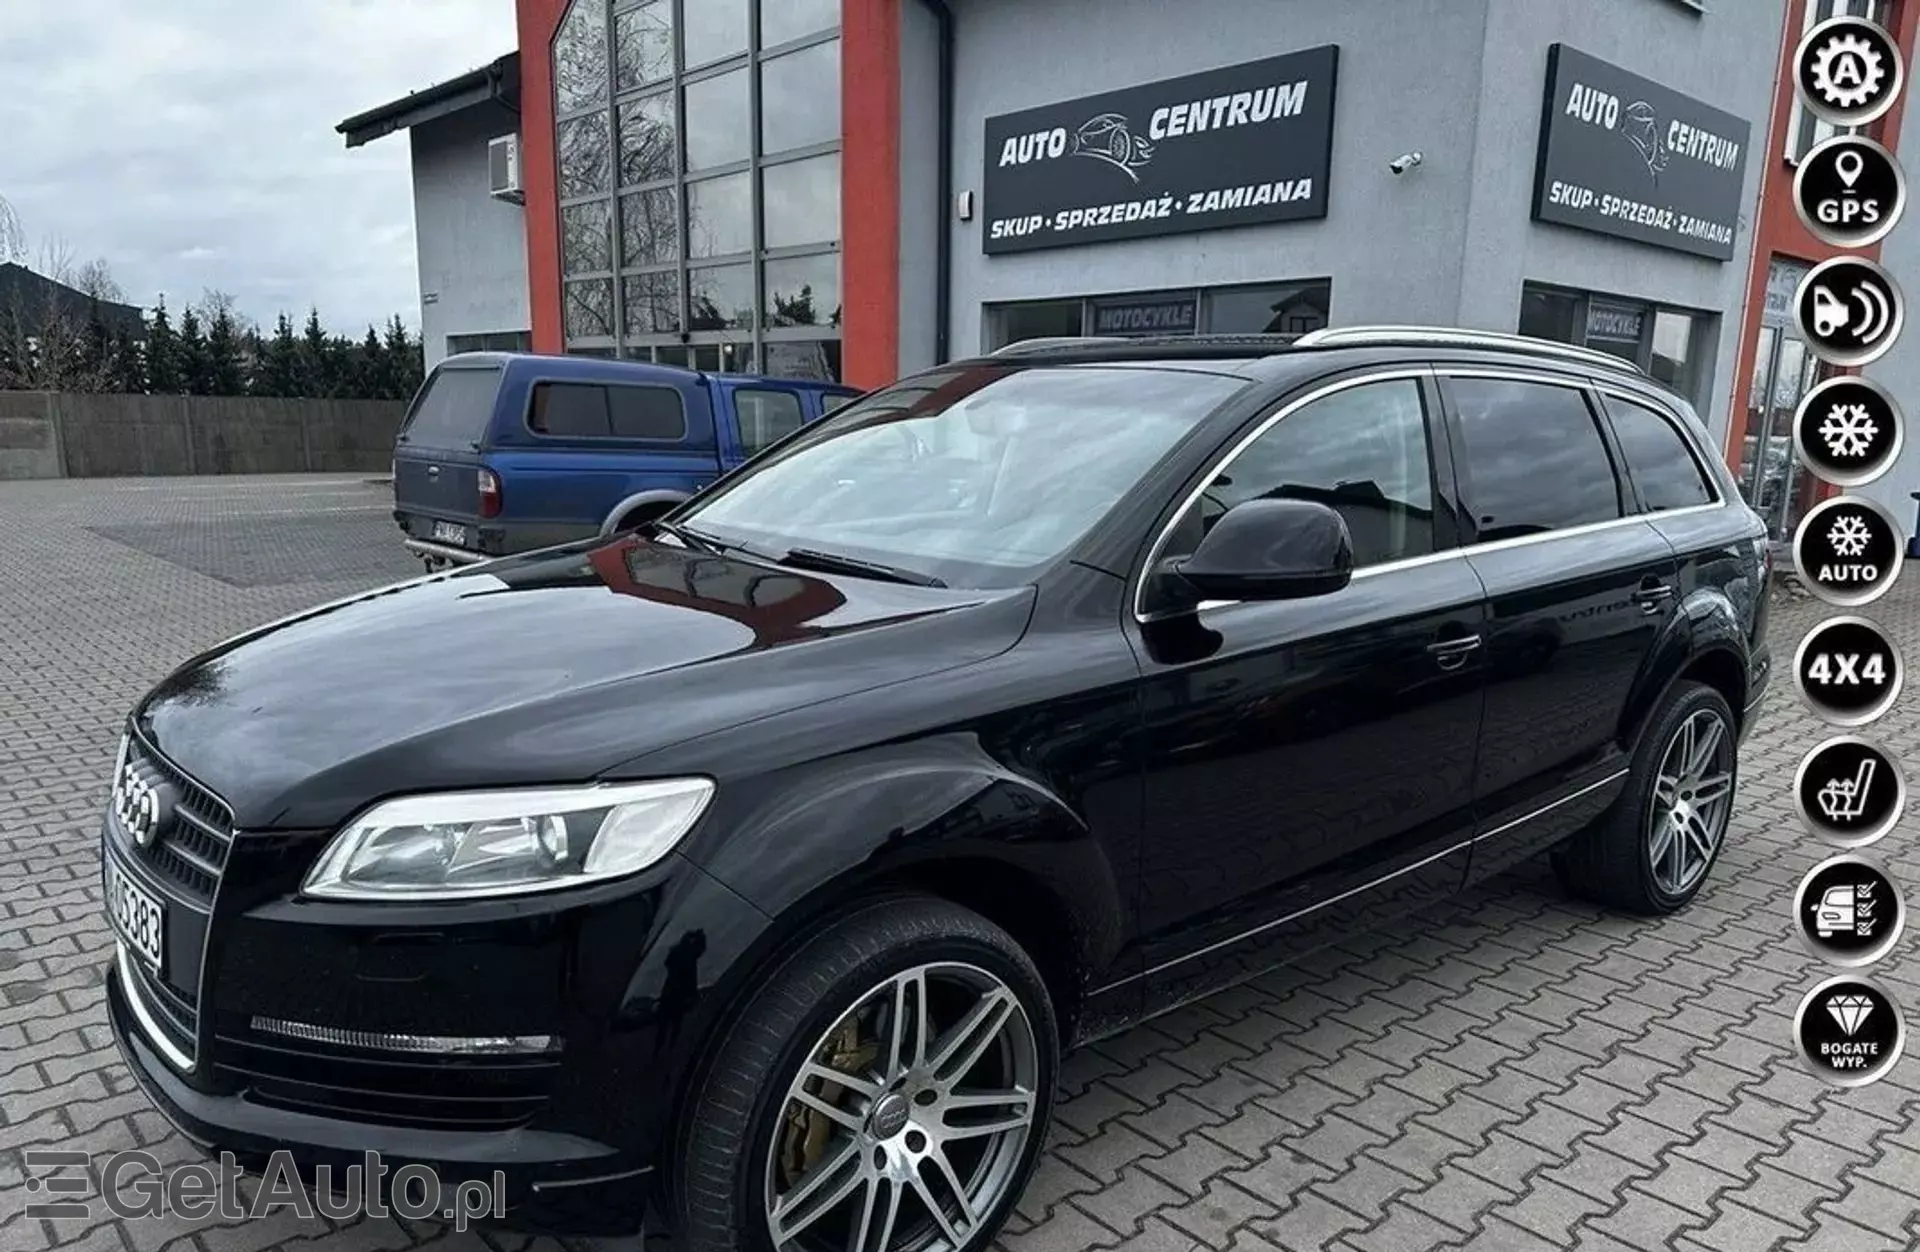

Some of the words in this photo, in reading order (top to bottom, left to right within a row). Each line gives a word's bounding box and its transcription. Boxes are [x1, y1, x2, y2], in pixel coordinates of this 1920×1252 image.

[999, 127, 1066, 167] AUTO
[1149, 81, 1308, 140] CENTRUM
[1565, 83, 1619, 130] AUTO
[1667, 119, 1740, 172] CENTRUM
[990, 215, 1043, 239] SKUP
[1054, 192, 1172, 231] SPRZEDAŻ
[1186, 178, 1312, 214] ZAMIANA
[1549, 180, 1593, 210] SKUP
[1600, 194, 1673, 231] SPRZEDAŻ
[1678, 214, 1733, 245] ZAMIANA
[1099, 303, 1194, 331] MOTOCYKLE
